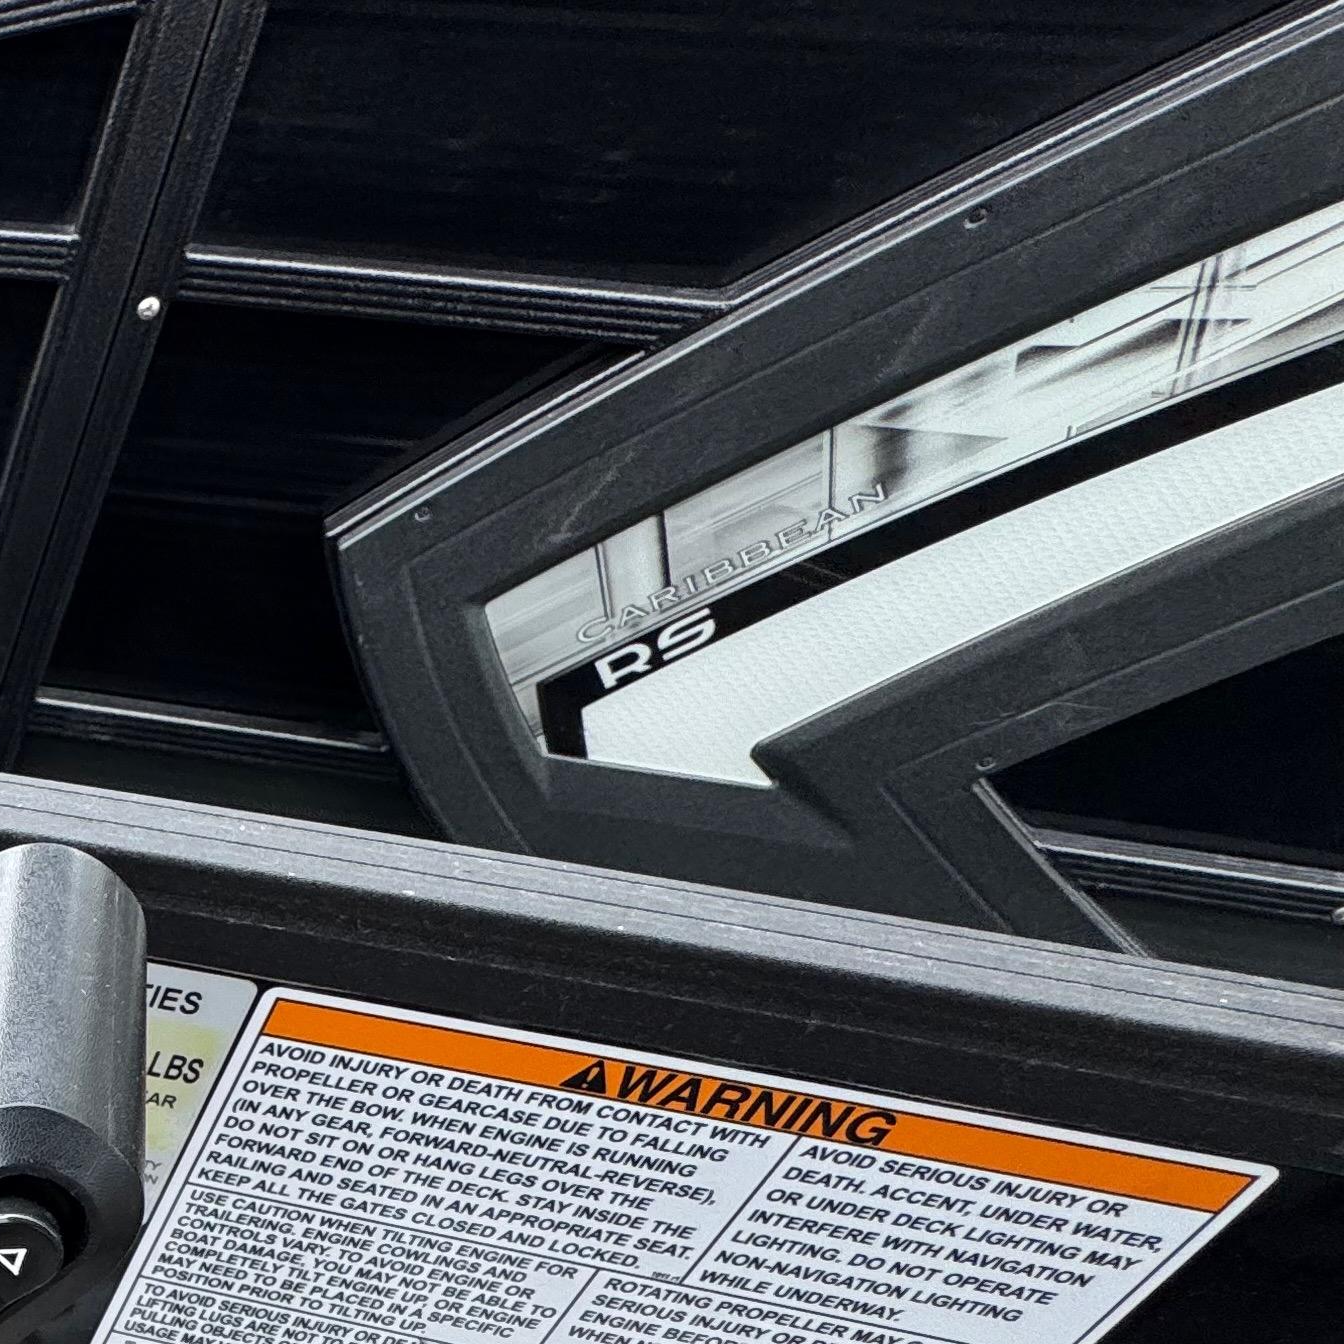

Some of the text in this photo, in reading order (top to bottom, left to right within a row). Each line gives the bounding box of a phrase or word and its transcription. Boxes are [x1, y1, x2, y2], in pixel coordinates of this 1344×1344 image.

[577, 483, 890, 645] CARIBBEAN
[594, 607, 717, 691] RS
[147, 1050, 204, 1083] LBS
[259, 1042, 771, 1148] AVOID INJURY OR DEATH FROM CONTACT WITH
[617, 1066, 897, 1146] WARNING
[232, 1098, 715, 1205] (IN ANY GEAR, FORWARD-NEUTRAL-REVERSE),
[242, 1080, 698, 1177] OVER THE BOW. WHEN ENGINE IS RUNNING
[250, 1061, 729, 1162] PROPELLER OR GEARCASE DUE TO FALLING
[223, 1116, 654, 1211] DO NOT SIT ON OR HANG LEGS OVER THE
[799, 1145, 1128, 1217] AVOID SERIOUS INJURY OR
[190, 1189, 578, 1279] USE CAUTION WHEN TILTING ENGINE FOR
[747, 1209, 1095, 1287] INTERFERE WITH NAVIGATION
[766, 1189, 1143, 1270] OR UNDER DECK LIGHTING MAY
[782, 1167, 1163, 1253] DEATH. ACCENT, UNDER WATER,
[699, 1270, 904, 1321] WHILE UNDERWAY.
[714, 1250, 1023, 1322] NON-NAVIGATION LIGHTING
[731, 1230, 1058, 1305] LIGHTING. DO NOT OPERATE
[144, 1283, 165, 1296] TO
[166, 1289, 216, 1308] AVOID
[218, 1300, 291, 1324] SERIOUS
[291, 1316, 354, 1338] INJURY
[354, 1330, 381, 1344] OR
[592, 1294, 687, 1322] SERIOUS
[689, 1314, 771, 1339] INJURY
[603, 1278, 713, 1309] ROTATING
[714, 1301, 849, 1338] PROPELLER
